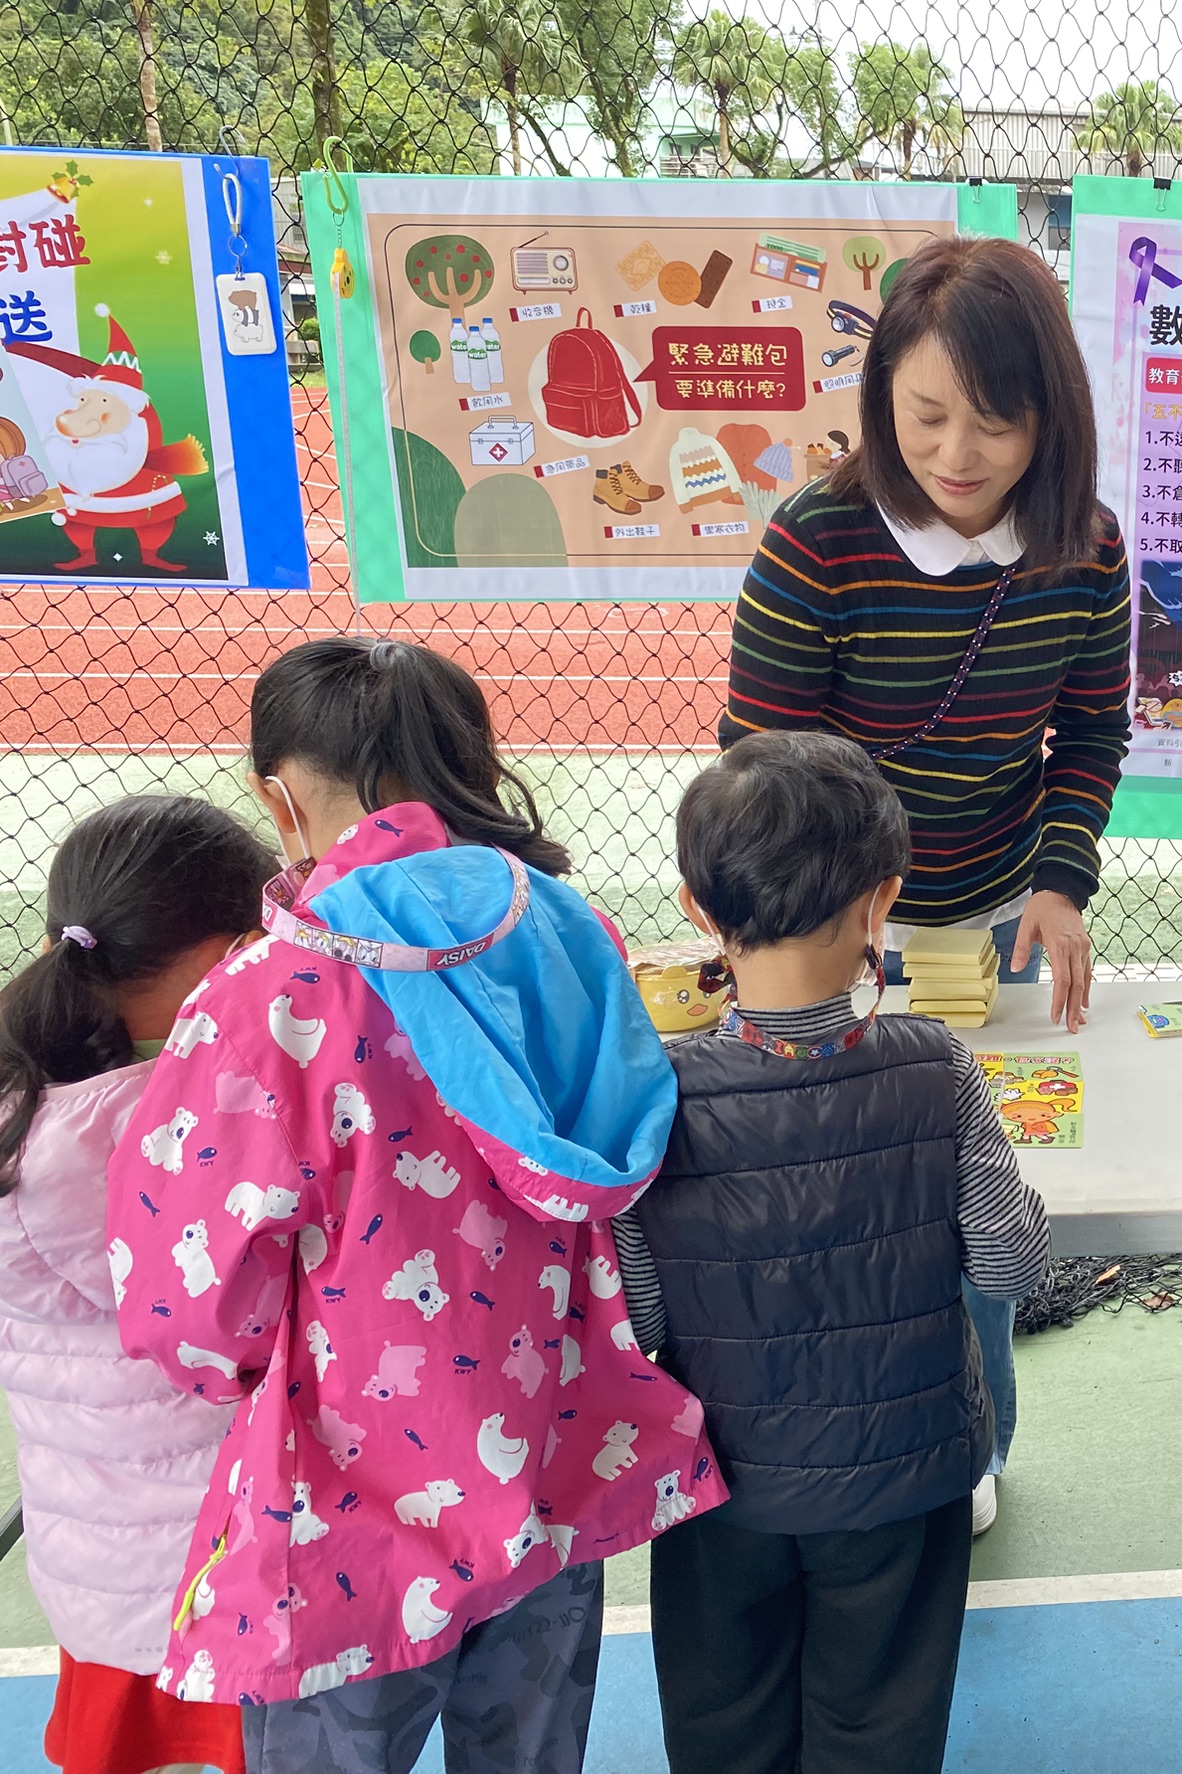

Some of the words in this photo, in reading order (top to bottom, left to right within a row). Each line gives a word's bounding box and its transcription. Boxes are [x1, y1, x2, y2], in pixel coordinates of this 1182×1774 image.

[630, 302, 651, 315] 乾糧
[766, 297, 787, 309] 現金
[522, 305, 554, 318] 收音機
[668, 343, 788, 366] 緊急避難包
[471, 395, 504, 408] 飲用水
[615, 526, 656, 537] 外出鞋子
[437, 941, 486, 966] DAISY
[459, 1557, 475, 1569] KWY
